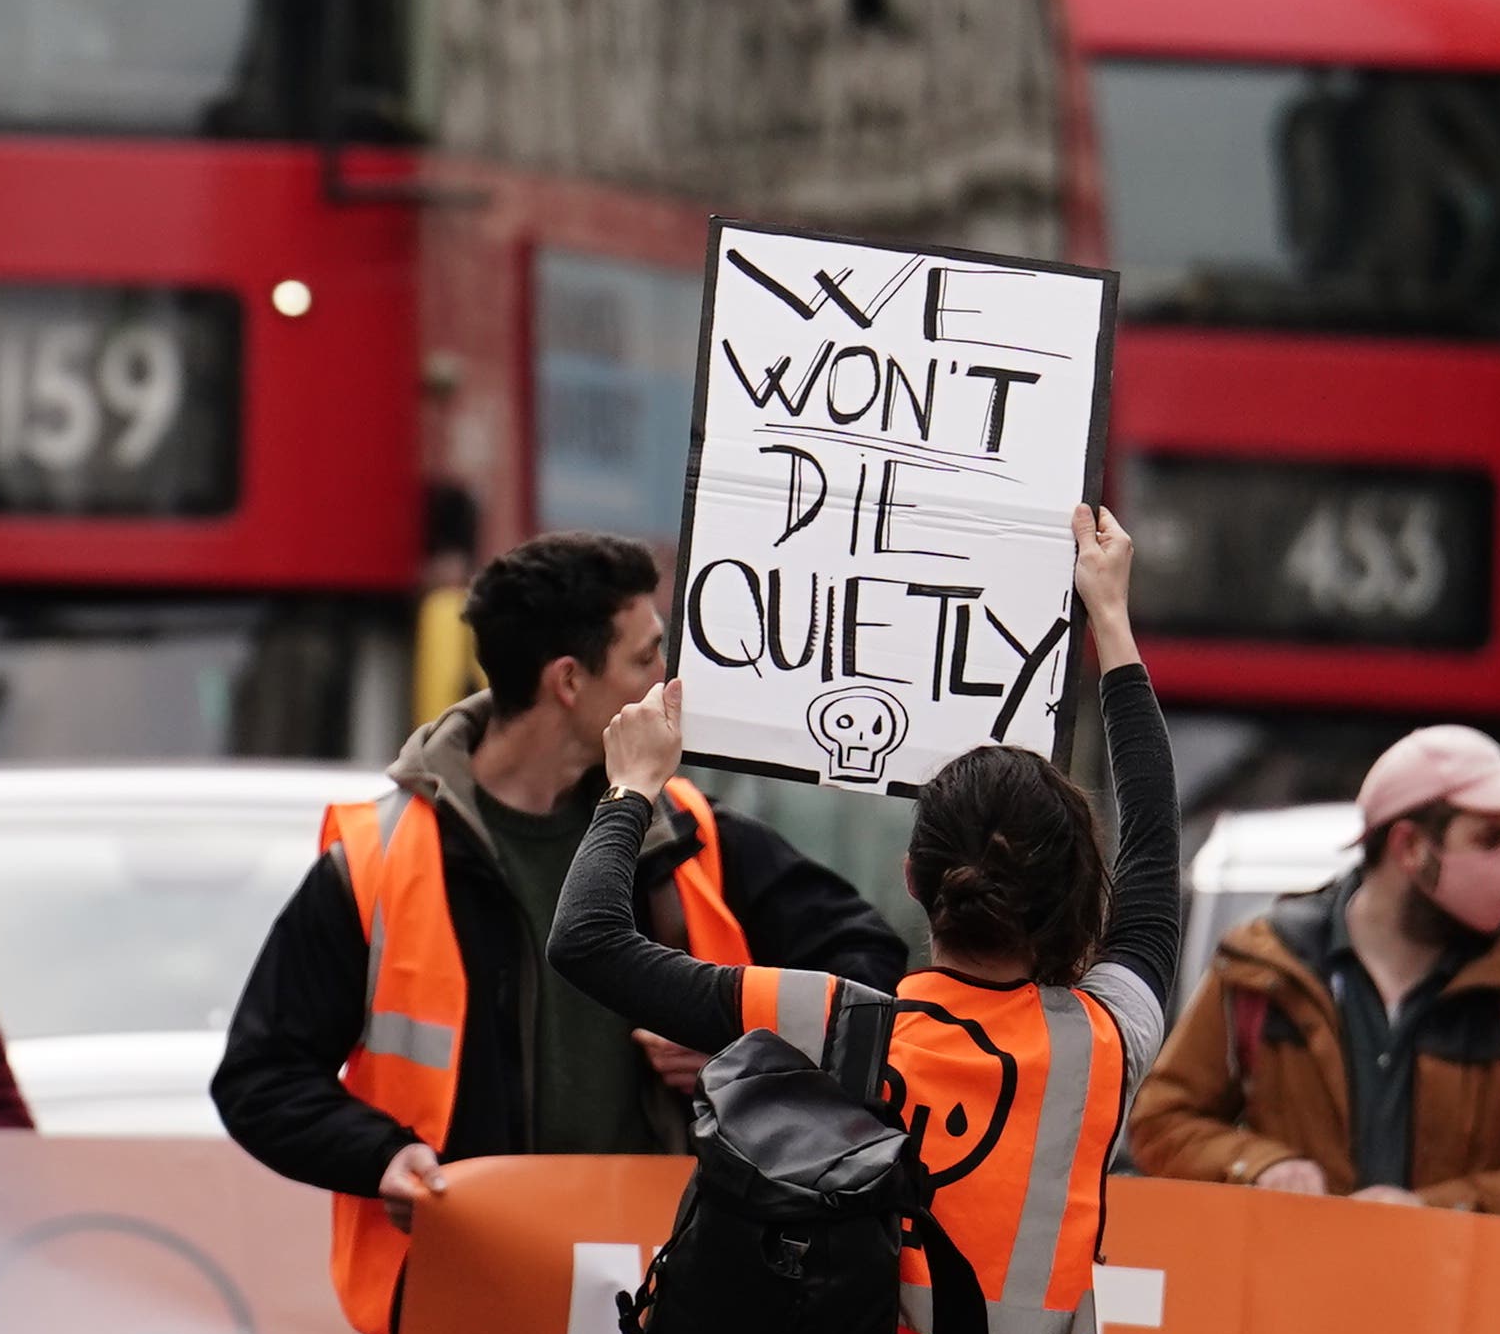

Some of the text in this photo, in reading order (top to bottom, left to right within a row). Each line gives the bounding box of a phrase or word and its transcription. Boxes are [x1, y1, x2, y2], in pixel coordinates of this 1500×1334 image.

[727, 253, 1073, 360] WE
[721, 339, 1042, 452] WON'T
[760, 444, 970, 560] DIE
